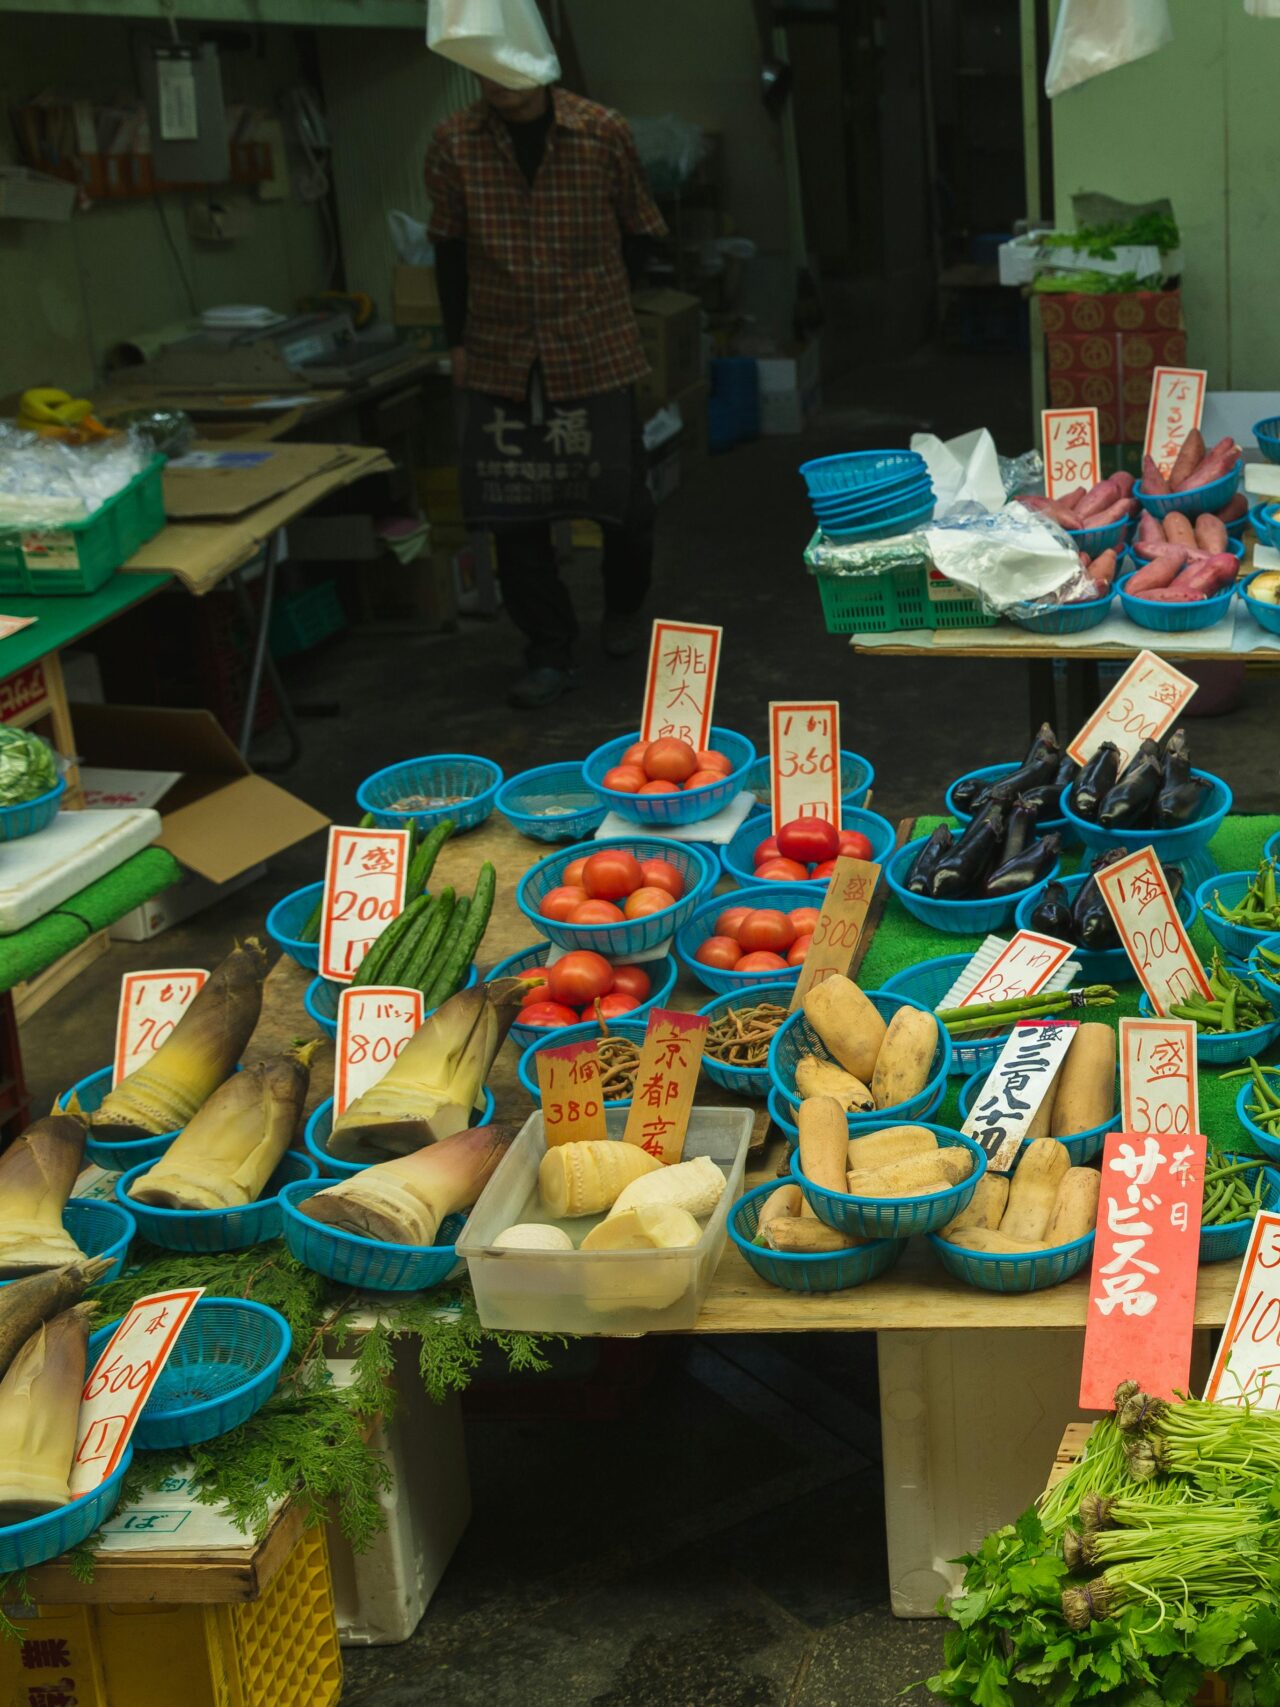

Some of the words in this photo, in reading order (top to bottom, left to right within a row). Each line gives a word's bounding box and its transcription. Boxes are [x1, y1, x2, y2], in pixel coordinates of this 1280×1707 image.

[481, 406, 592, 456] 七福
[1051, 458, 1093, 482] 380
[1106, 698, 1158, 741] 300
[778, 747, 837, 778] 350
[331, 890, 396, 921] 200
[812, 915, 859, 948] 300
[1132, 921, 1181, 970] 200
[546, 1101, 599, 1125] 380
[1130, 1096, 1190, 1134] 300
[84, 1354, 155, 1401] 500
